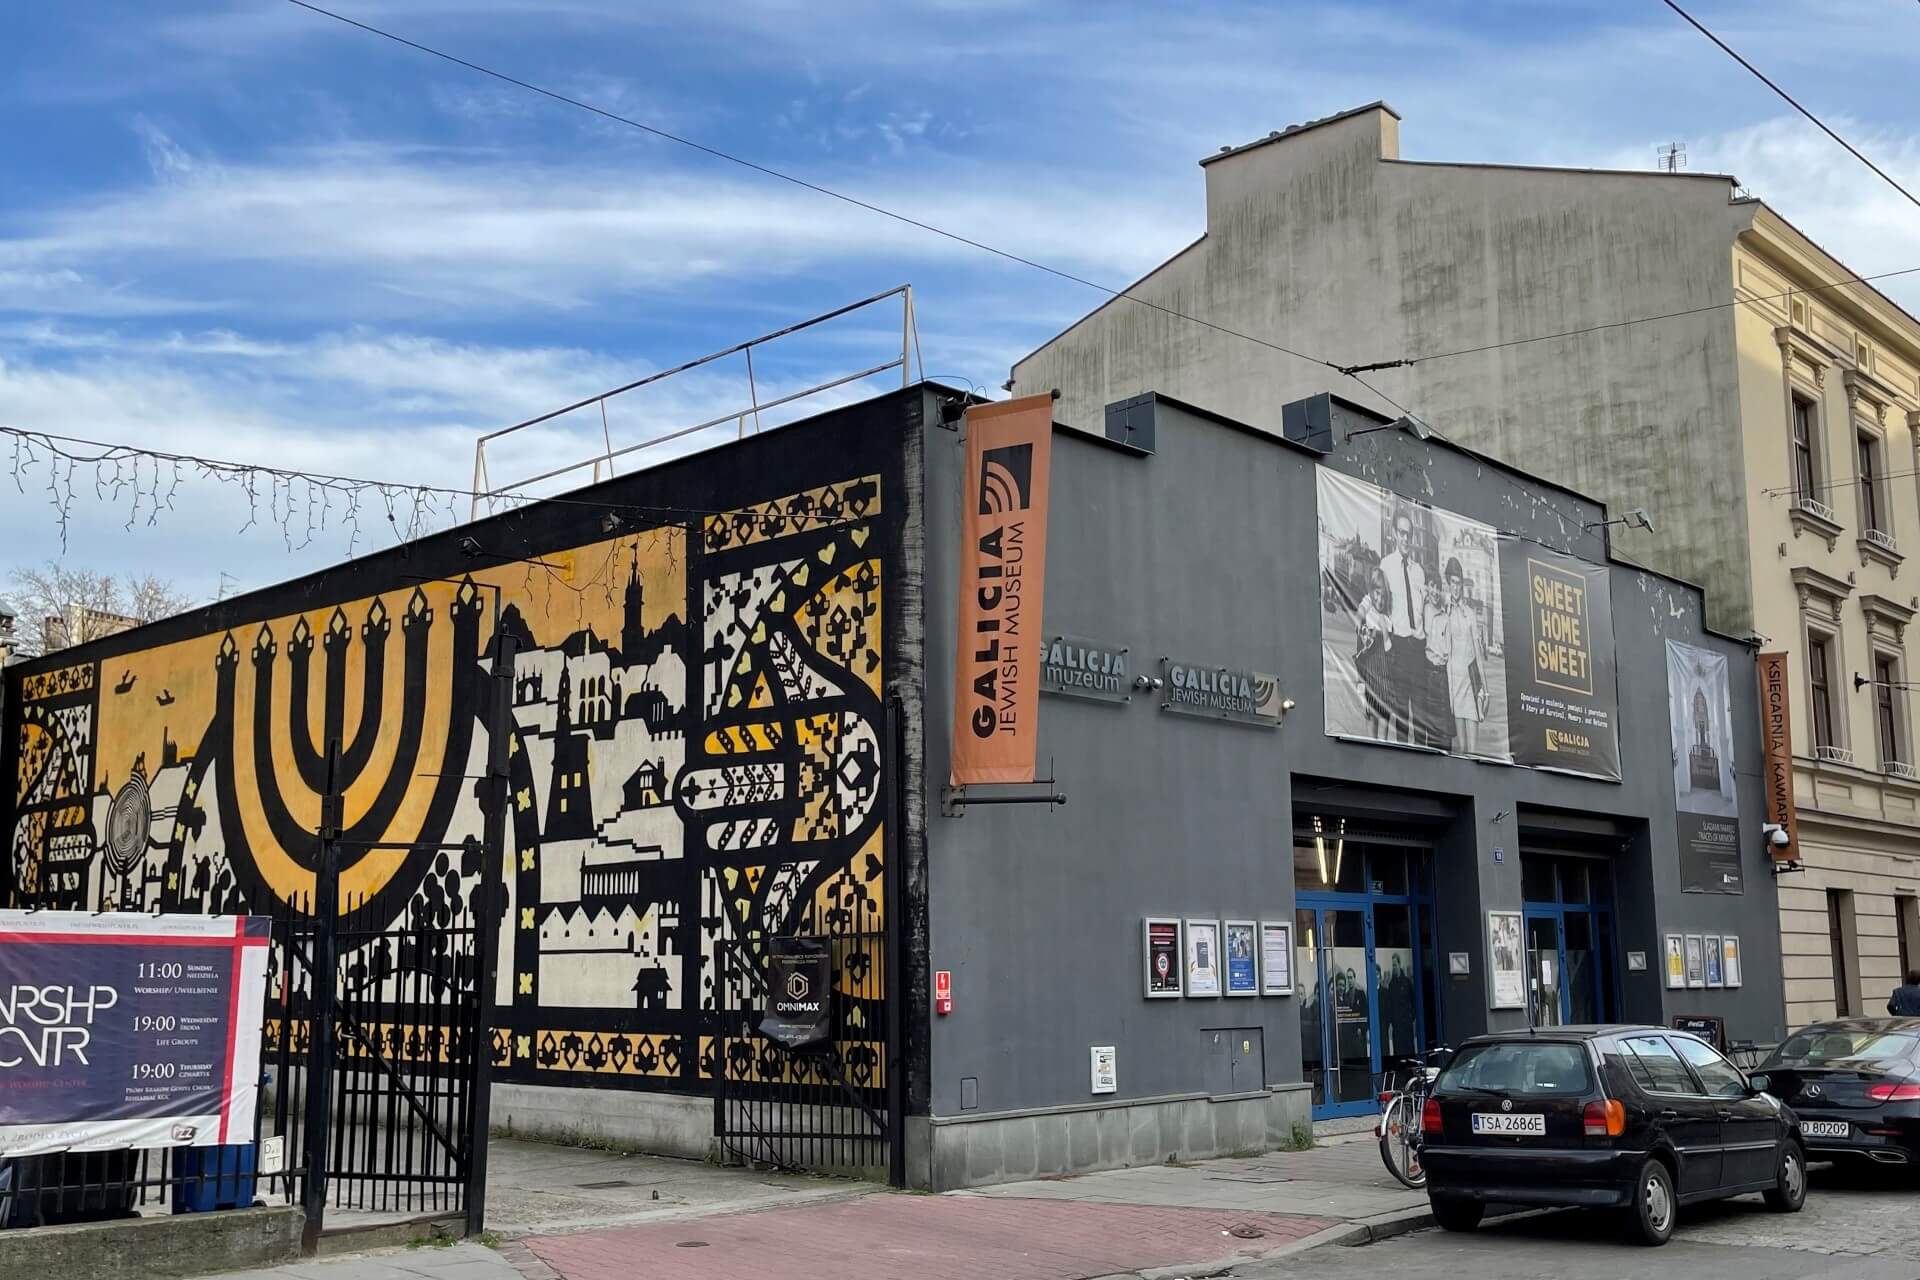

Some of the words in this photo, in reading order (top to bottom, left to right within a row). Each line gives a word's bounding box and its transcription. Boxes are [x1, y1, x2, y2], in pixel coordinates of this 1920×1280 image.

[1005, 522, 1024, 635] MUSEUM
[1534, 575, 1582, 615] SWEET
[972, 526, 1003, 738] GALICIA
[1541, 608, 1580, 646] HOME
[1538, 640, 1586, 679] SWEET
[1000, 645, 1018, 736] JEWISH
[1047, 666, 1119, 692] muzeum
[1171, 665, 1251, 699] GALICIA
[1171, 688, 1207, 705] JEWISH
[1210, 696, 1254, 713] MUSEUM
[1768, 660, 1784, 750] KSIĘGARNIA
[1558, 732, 1590, 748] GALICJA
[138, 963, 182, 979] 11:00
[776, 1002, 820, 1012] OMNIMAX
[133, 1016, 176, 1032] 19:00
[132, 1063, 175, 1080] 19:00
[1480, 1116, 1501, 1130] TSA
[1505, 1116, 1542, 1131] 2686E
[1813, 1122, 1847, 1135] 80209
